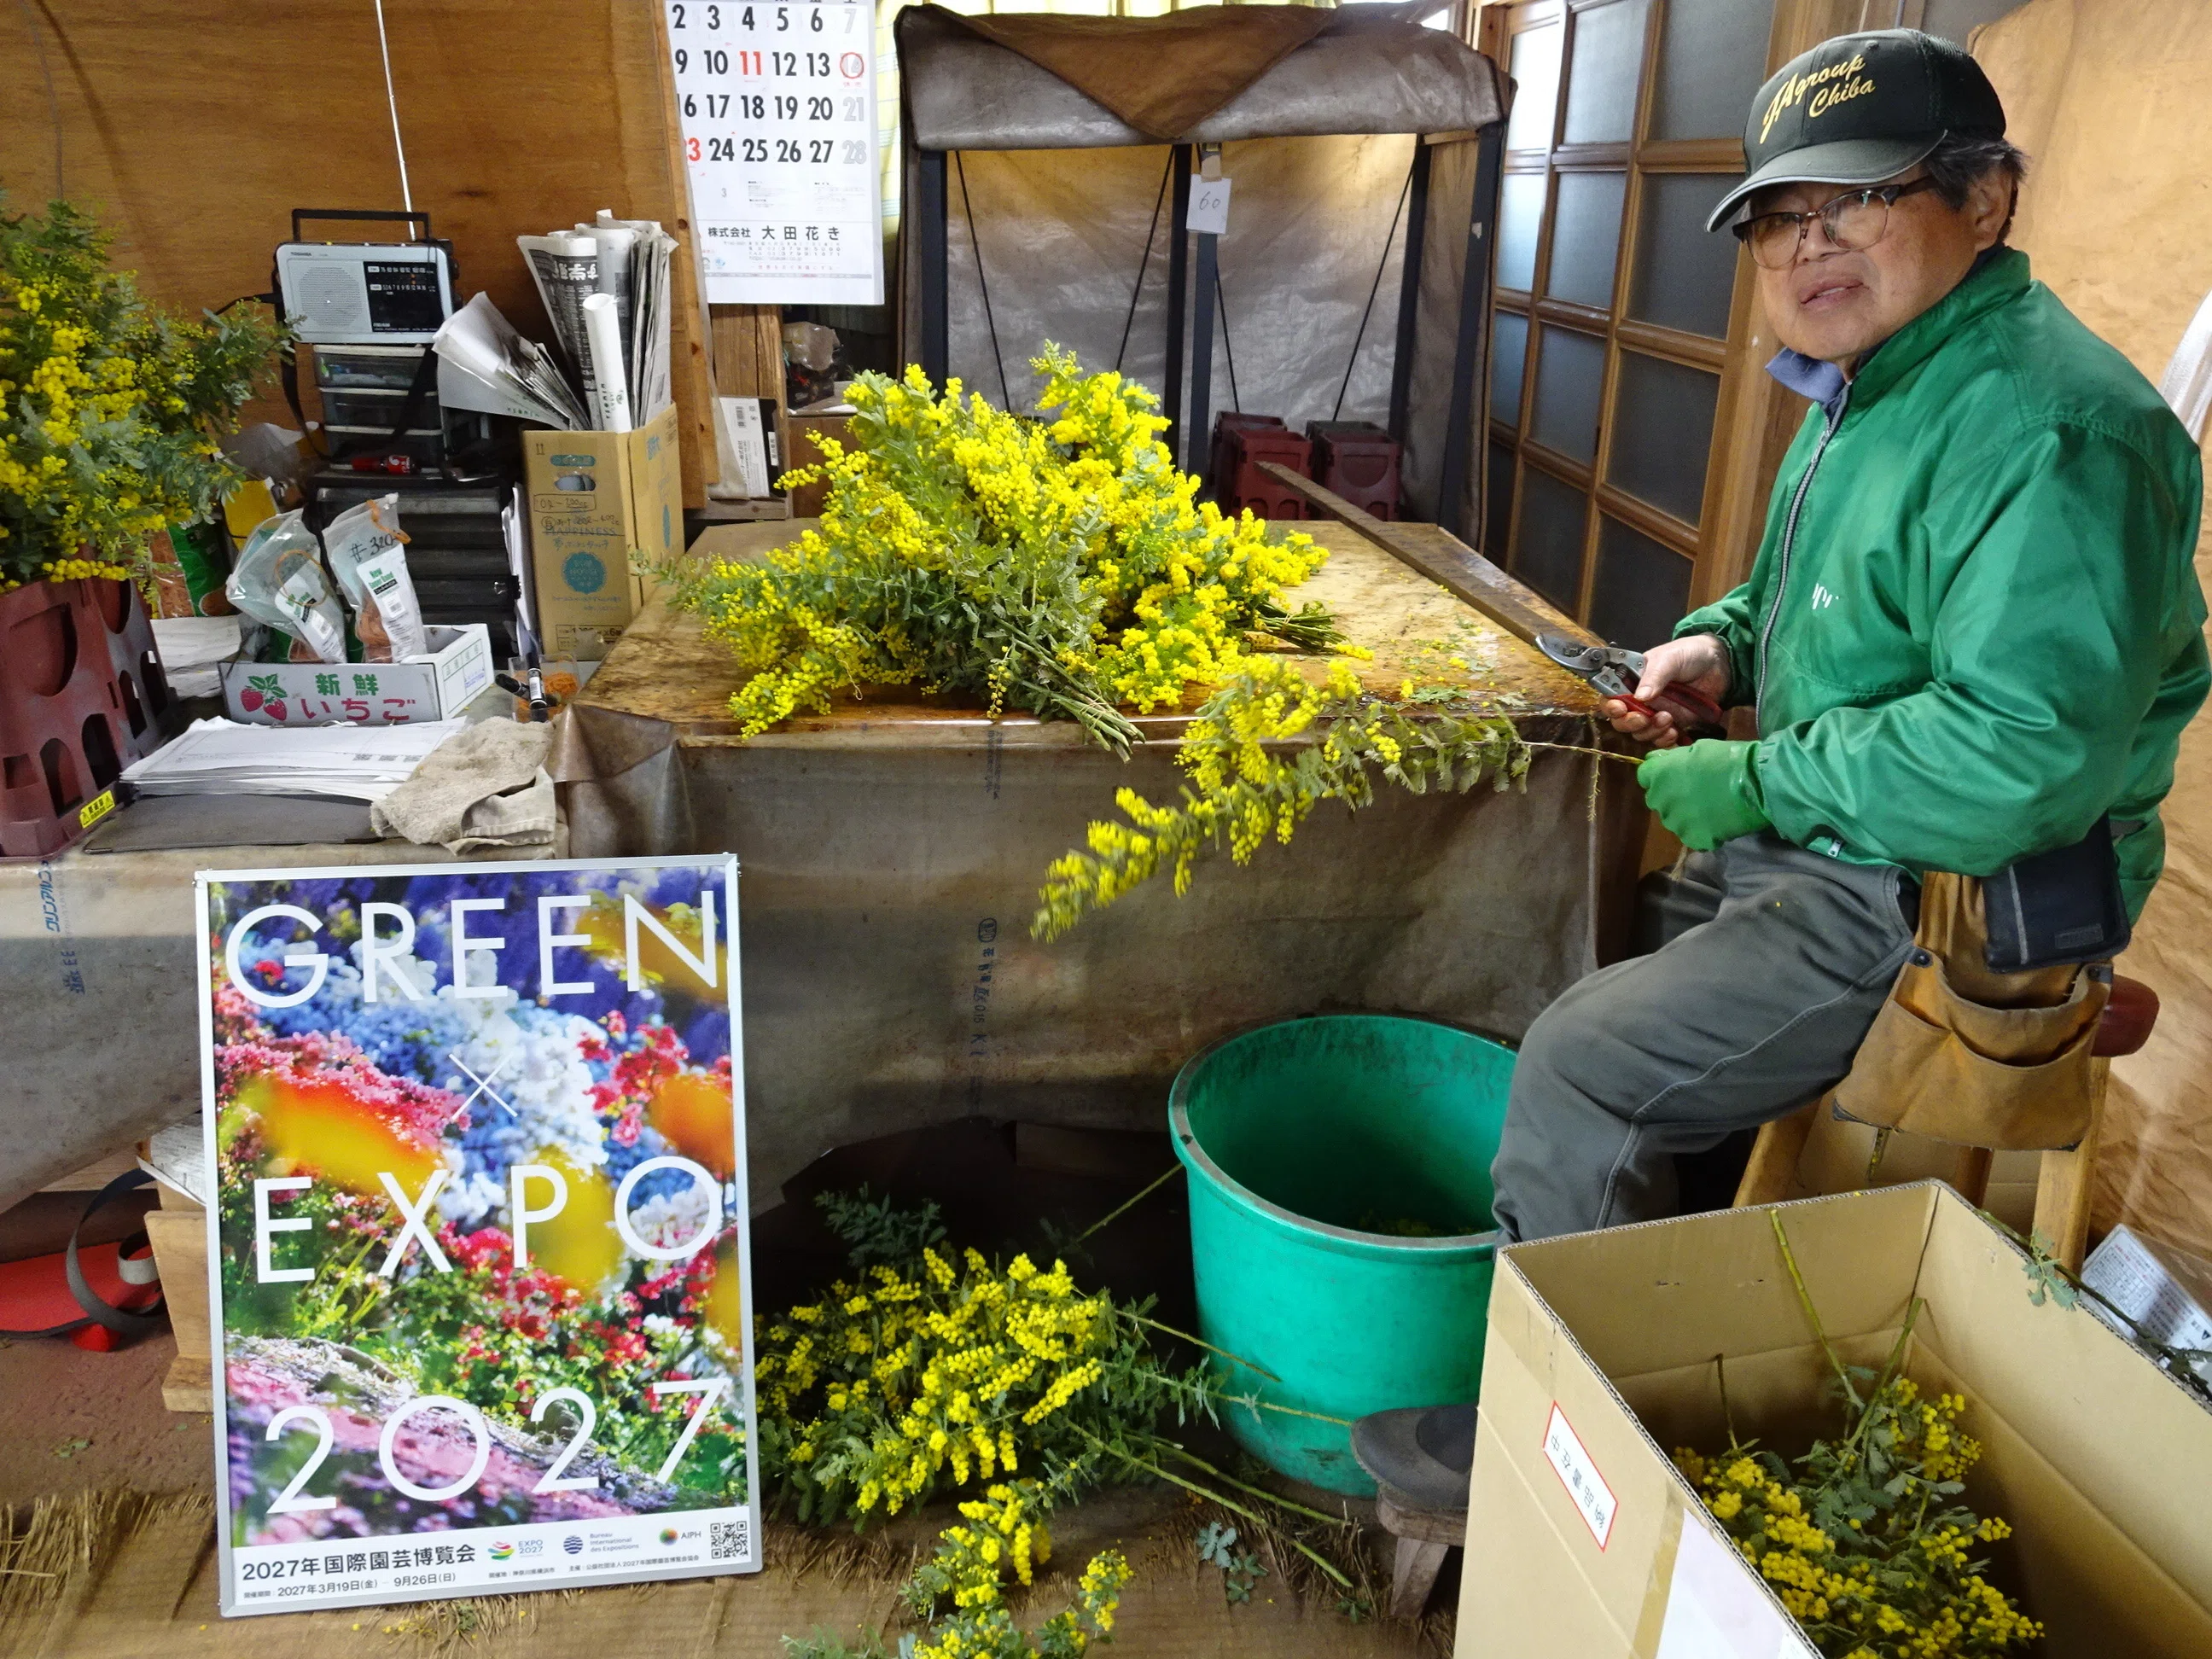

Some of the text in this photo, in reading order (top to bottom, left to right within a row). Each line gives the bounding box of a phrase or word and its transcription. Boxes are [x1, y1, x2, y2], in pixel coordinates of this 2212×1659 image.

[672, 4, 857, 33] 2 3 4 5 6 7
[675, 49, 688, 73] 9
[704, 49, 728, 75] 10
[739, 50, 762, 75] 11
[772, 51, 797, 76] 12
[806, 52, 830, 77] 13
[707, 94, 731, 118] 17
[741, 95, 765, 119] 18
[774, 96, 798, 119] 19
[807, 96, 833, 120] 20
[842, 96, 864, 121] 21
[1808, 75, 1877, 118] Chiba
[685, 137, 867, 164] 3 24 25 26 27 28
[1199, 191, 1221, 210] 60
[707, 225, 840, 240] 株式会社 大田花き
[315, 672, 379, 696] 新鮮
[300, 697, 416, 720] いちご
[226, 890, 718, 1009] GREEN
[254, 1155, 724, 1284] EXPO
[265, 1378, 727, 1515] 2027
[518, 1539, 543, 1548] EXPO
[602, 1544, 639, 1552] Expositions
[681, 1531, 701, 1540] AIPH
[242, 1544, 476, 1580] 2027年国際園芸博覧会
[519, 1546, 543, 1555] 2027
